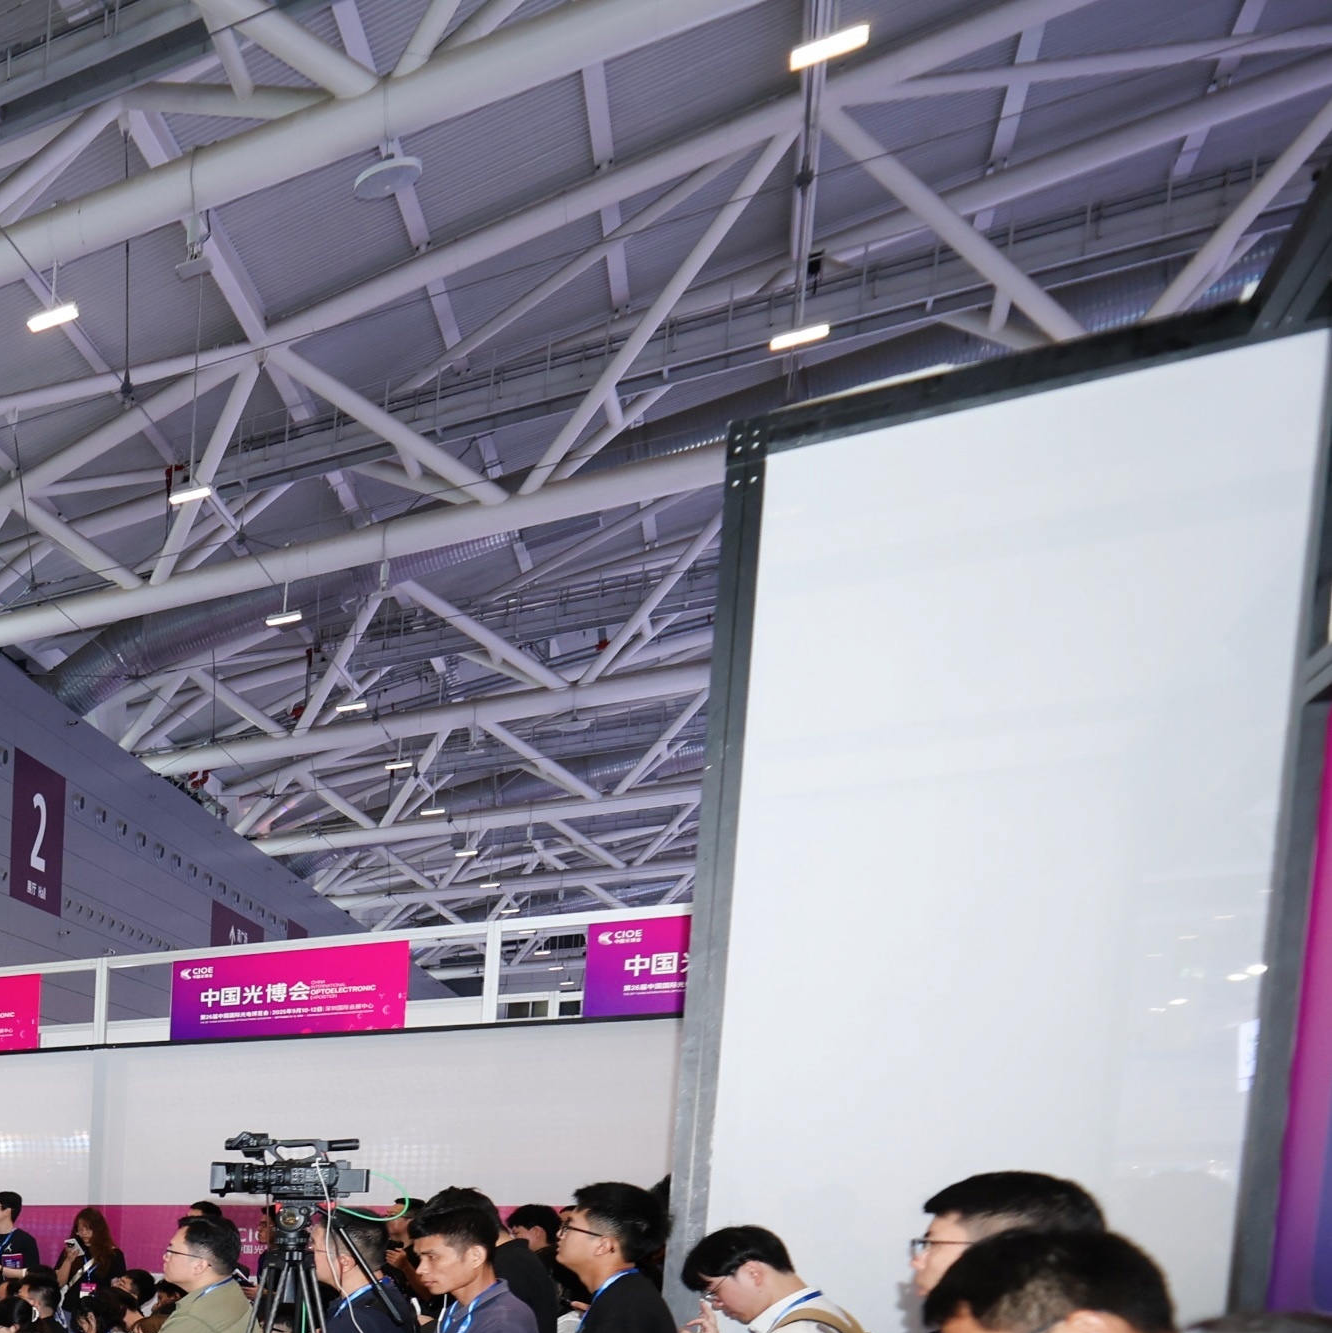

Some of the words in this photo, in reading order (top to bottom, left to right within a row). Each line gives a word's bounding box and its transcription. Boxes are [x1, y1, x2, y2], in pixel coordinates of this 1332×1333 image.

[30, 793, 47, 873] 2
[613, 929, 643, 939] CIOE
[192, 966, 214, 975] CIOE
[200, 981, 310, 1008] 中国光博会
[310, 984, 377, 996] OPTOELECTRONIC
